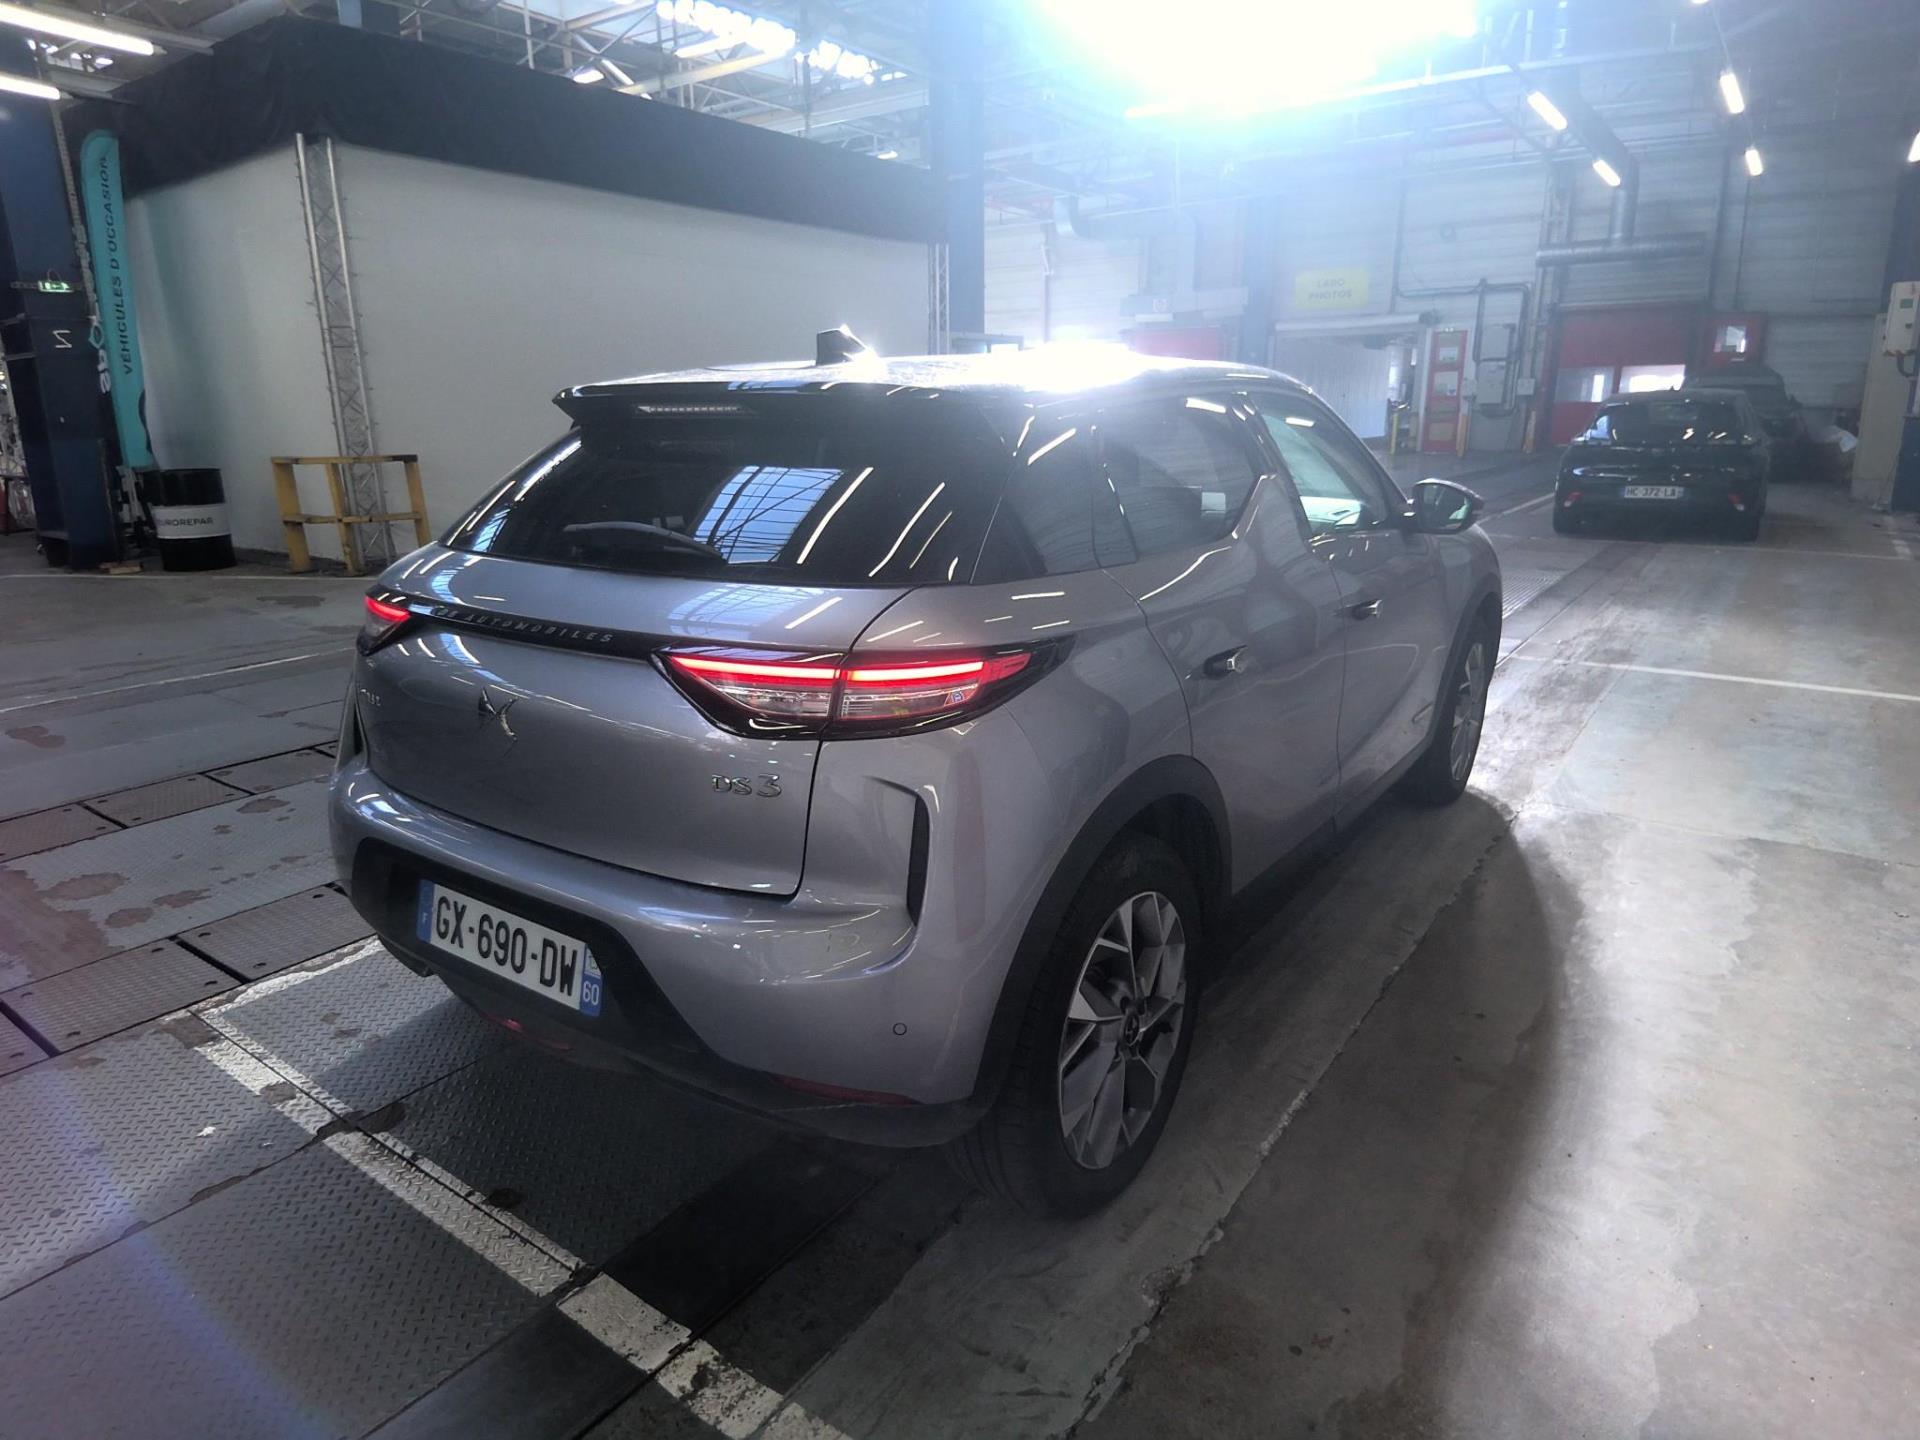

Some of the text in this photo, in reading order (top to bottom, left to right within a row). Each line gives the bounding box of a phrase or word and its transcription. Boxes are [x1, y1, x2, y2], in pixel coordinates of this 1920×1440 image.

[464, 614, 615, 644] AUTOMOBILES
[711, 772, 783, 798] DS 3
[435, 895, 579, 998] GX-690-DW
[582, 980, 600, 1006] 60
